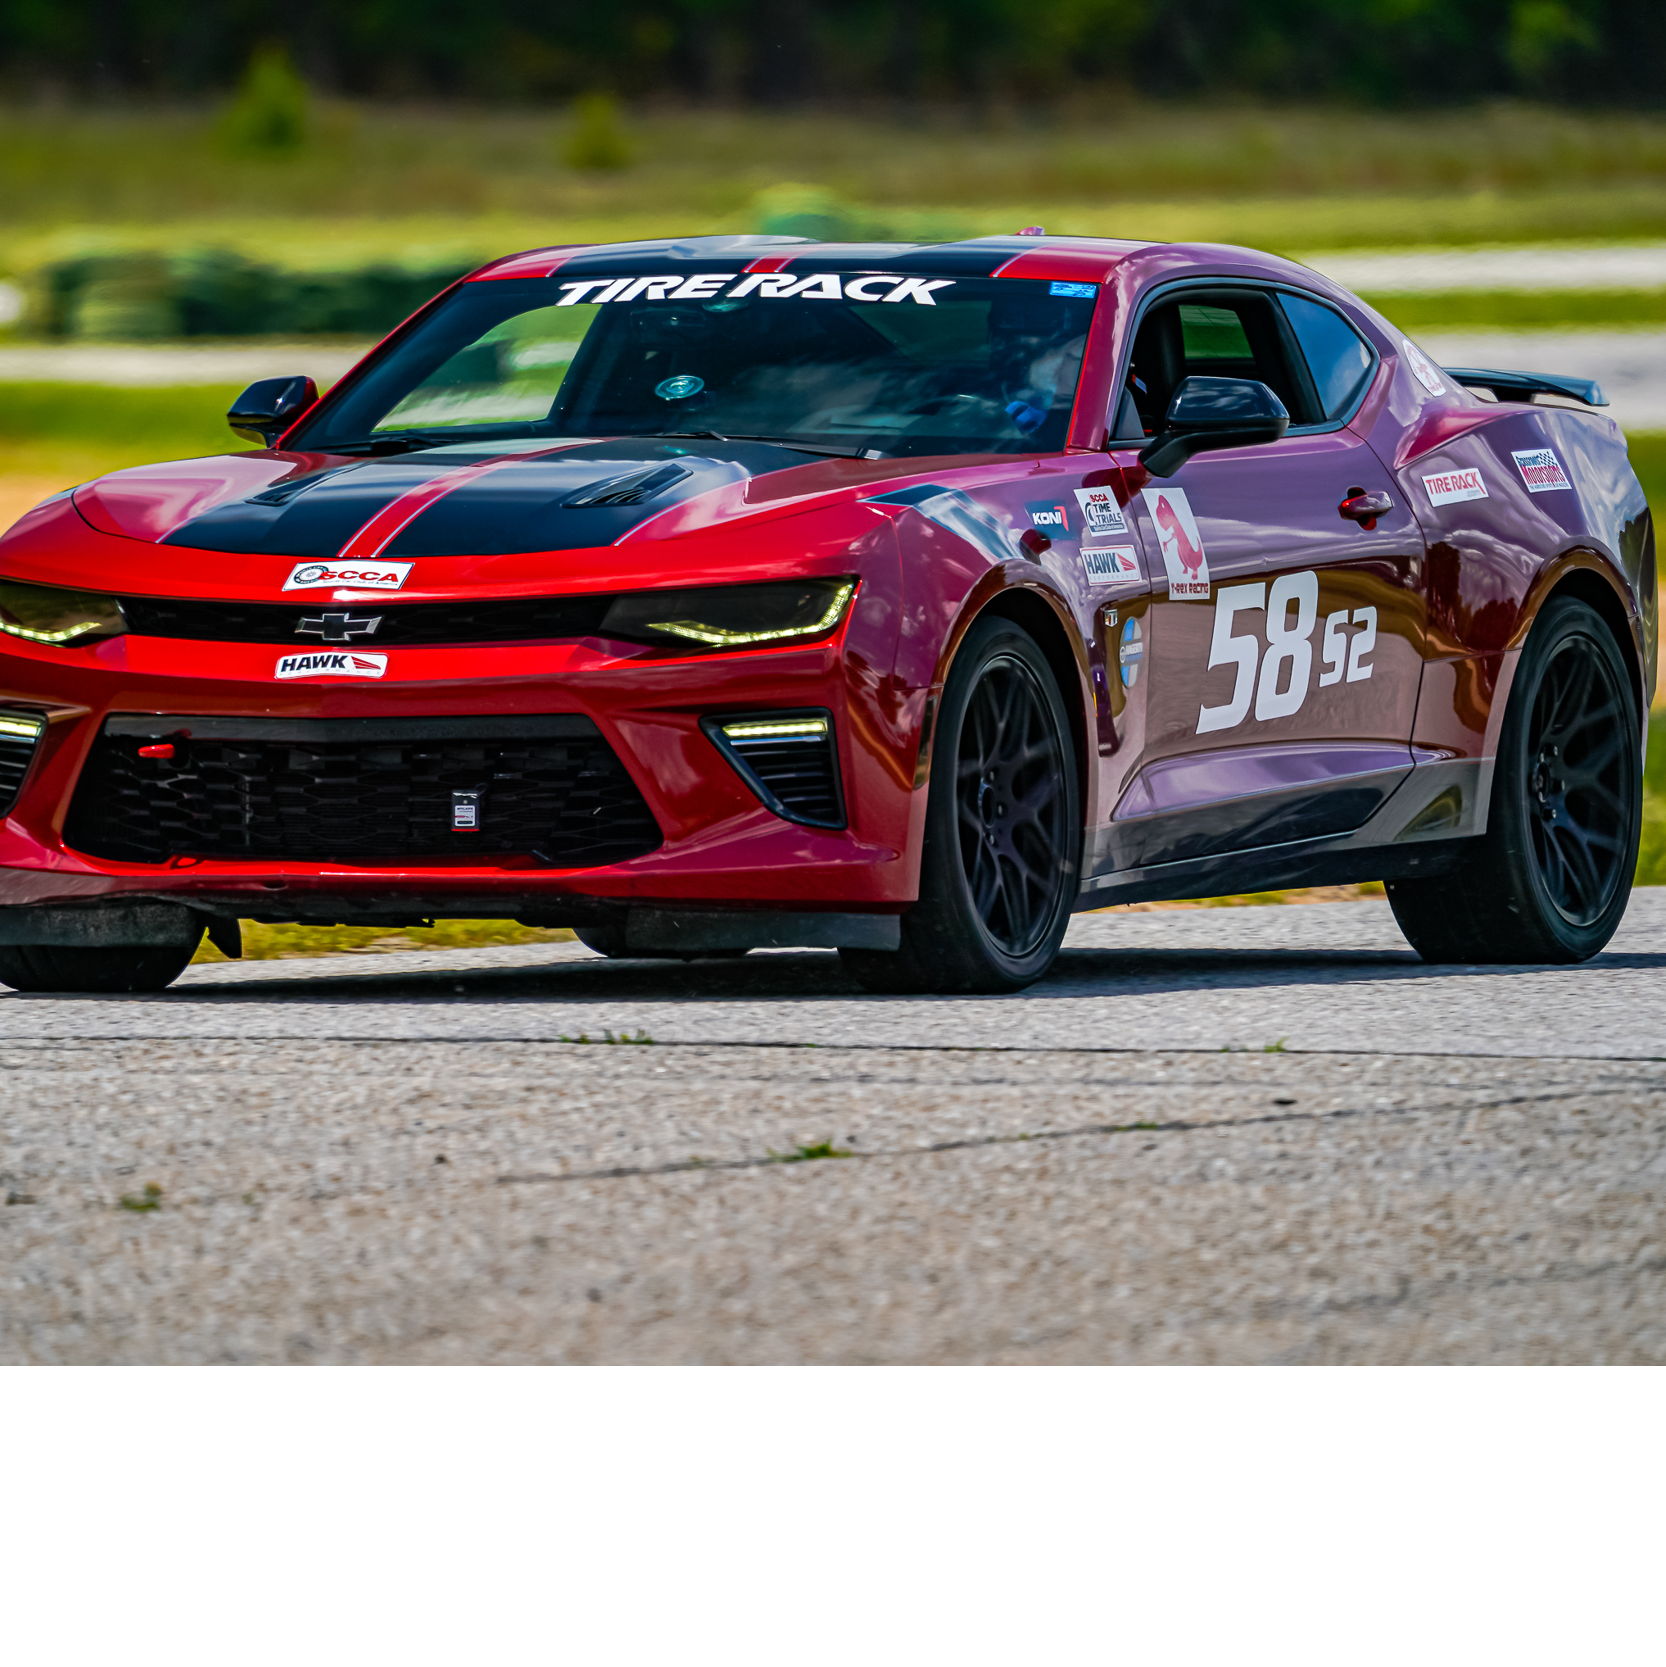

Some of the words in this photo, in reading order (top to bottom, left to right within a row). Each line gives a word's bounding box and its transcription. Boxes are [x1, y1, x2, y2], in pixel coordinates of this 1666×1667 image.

[555, 273, 738, 307] TIRE
[726, 273, 957, 306] RACK
[1425, 476, 1453, 496] TIRE
[1451, 472, 1486, 495] RACK
[1089, 493, 1109, 502] SCCA
[1093, 502, 1111, 513] TIME
[1032, 511, 1063, 525] KONI
[1095, 513, 1122, 525] TRIALS
[1084, 553, 1120, 575] HAWK
[319, 570, 399, 582] SCCA
[1195, 570, 1319, 735] 58
[280, 655, 348, 672] HAWK
